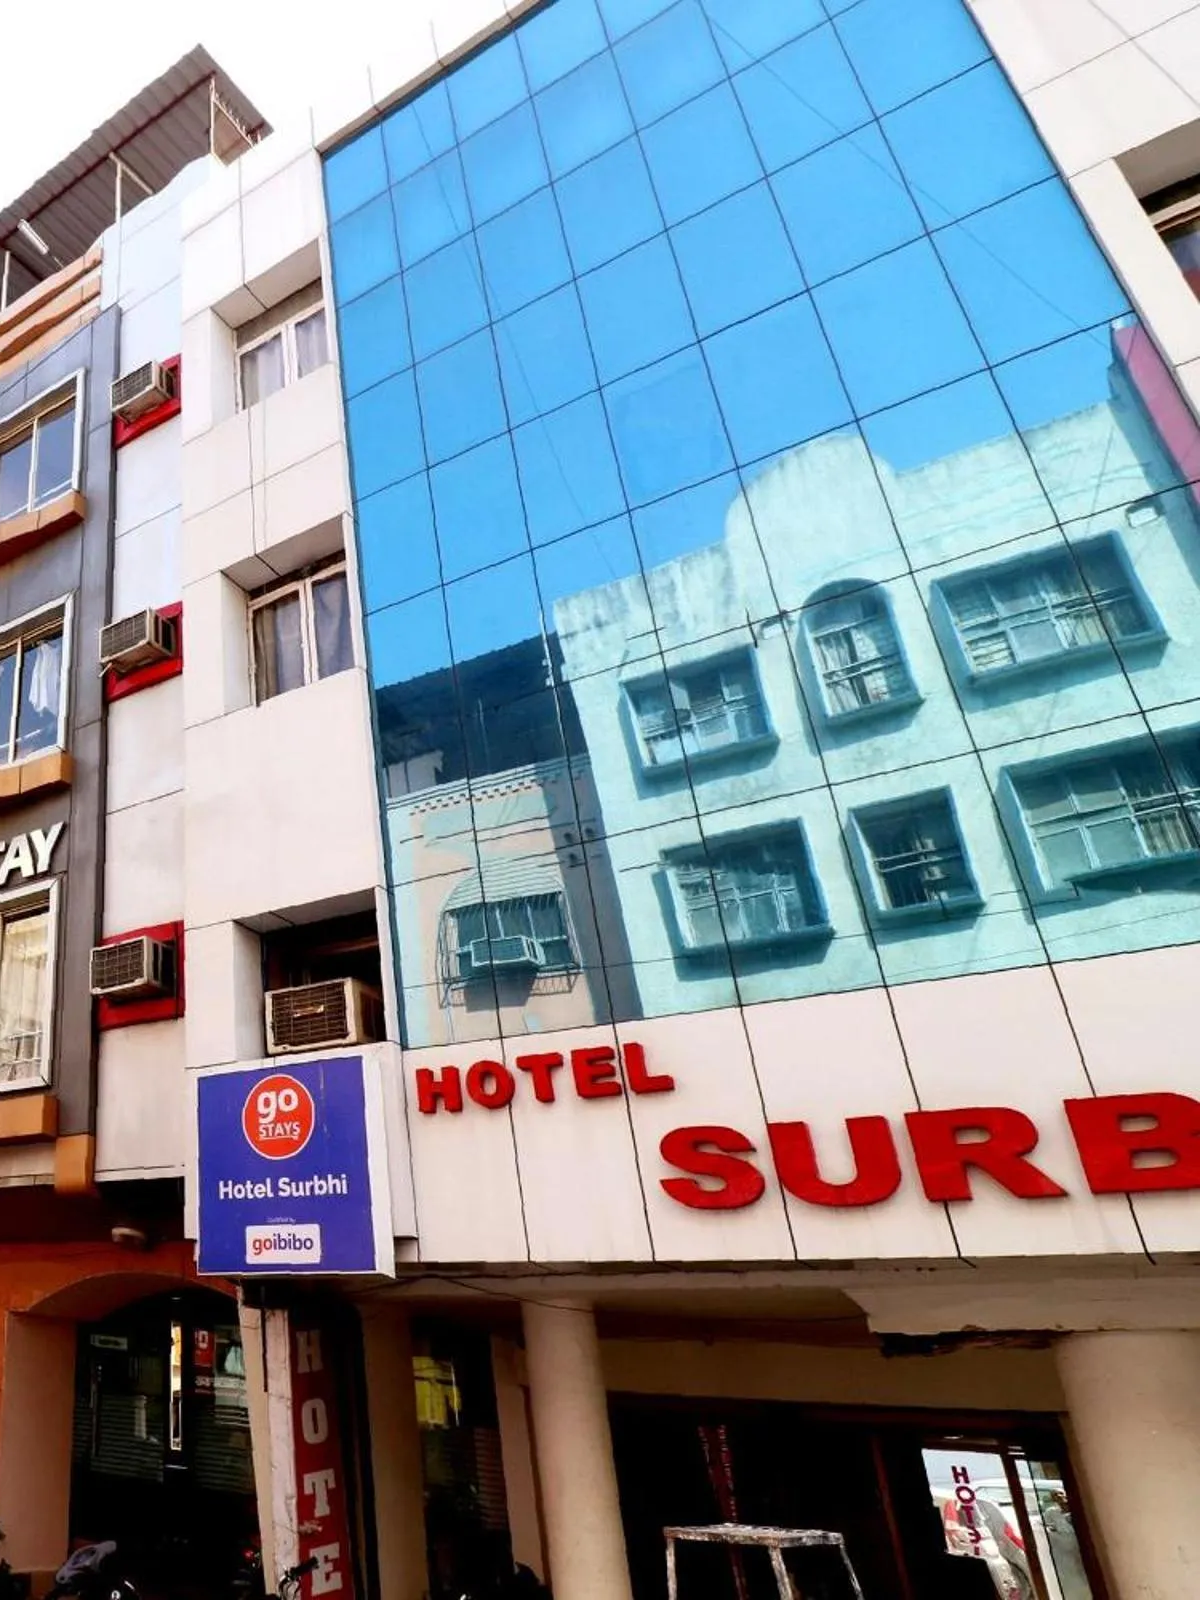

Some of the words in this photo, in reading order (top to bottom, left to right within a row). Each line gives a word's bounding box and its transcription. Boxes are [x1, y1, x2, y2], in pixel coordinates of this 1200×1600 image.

[415, 1043, 674, 1114] HOTEL
[256, 1088, 298, 1123] go
[259, 1121, 300, 1138] STAYS
[659, 1092, 1200, 1210] SURB
[218, 1178, 274, 1200] Hotel
[278, 1174, 348, 1197] Surbhi
[252, 1233, 313, 1255] goibibo
